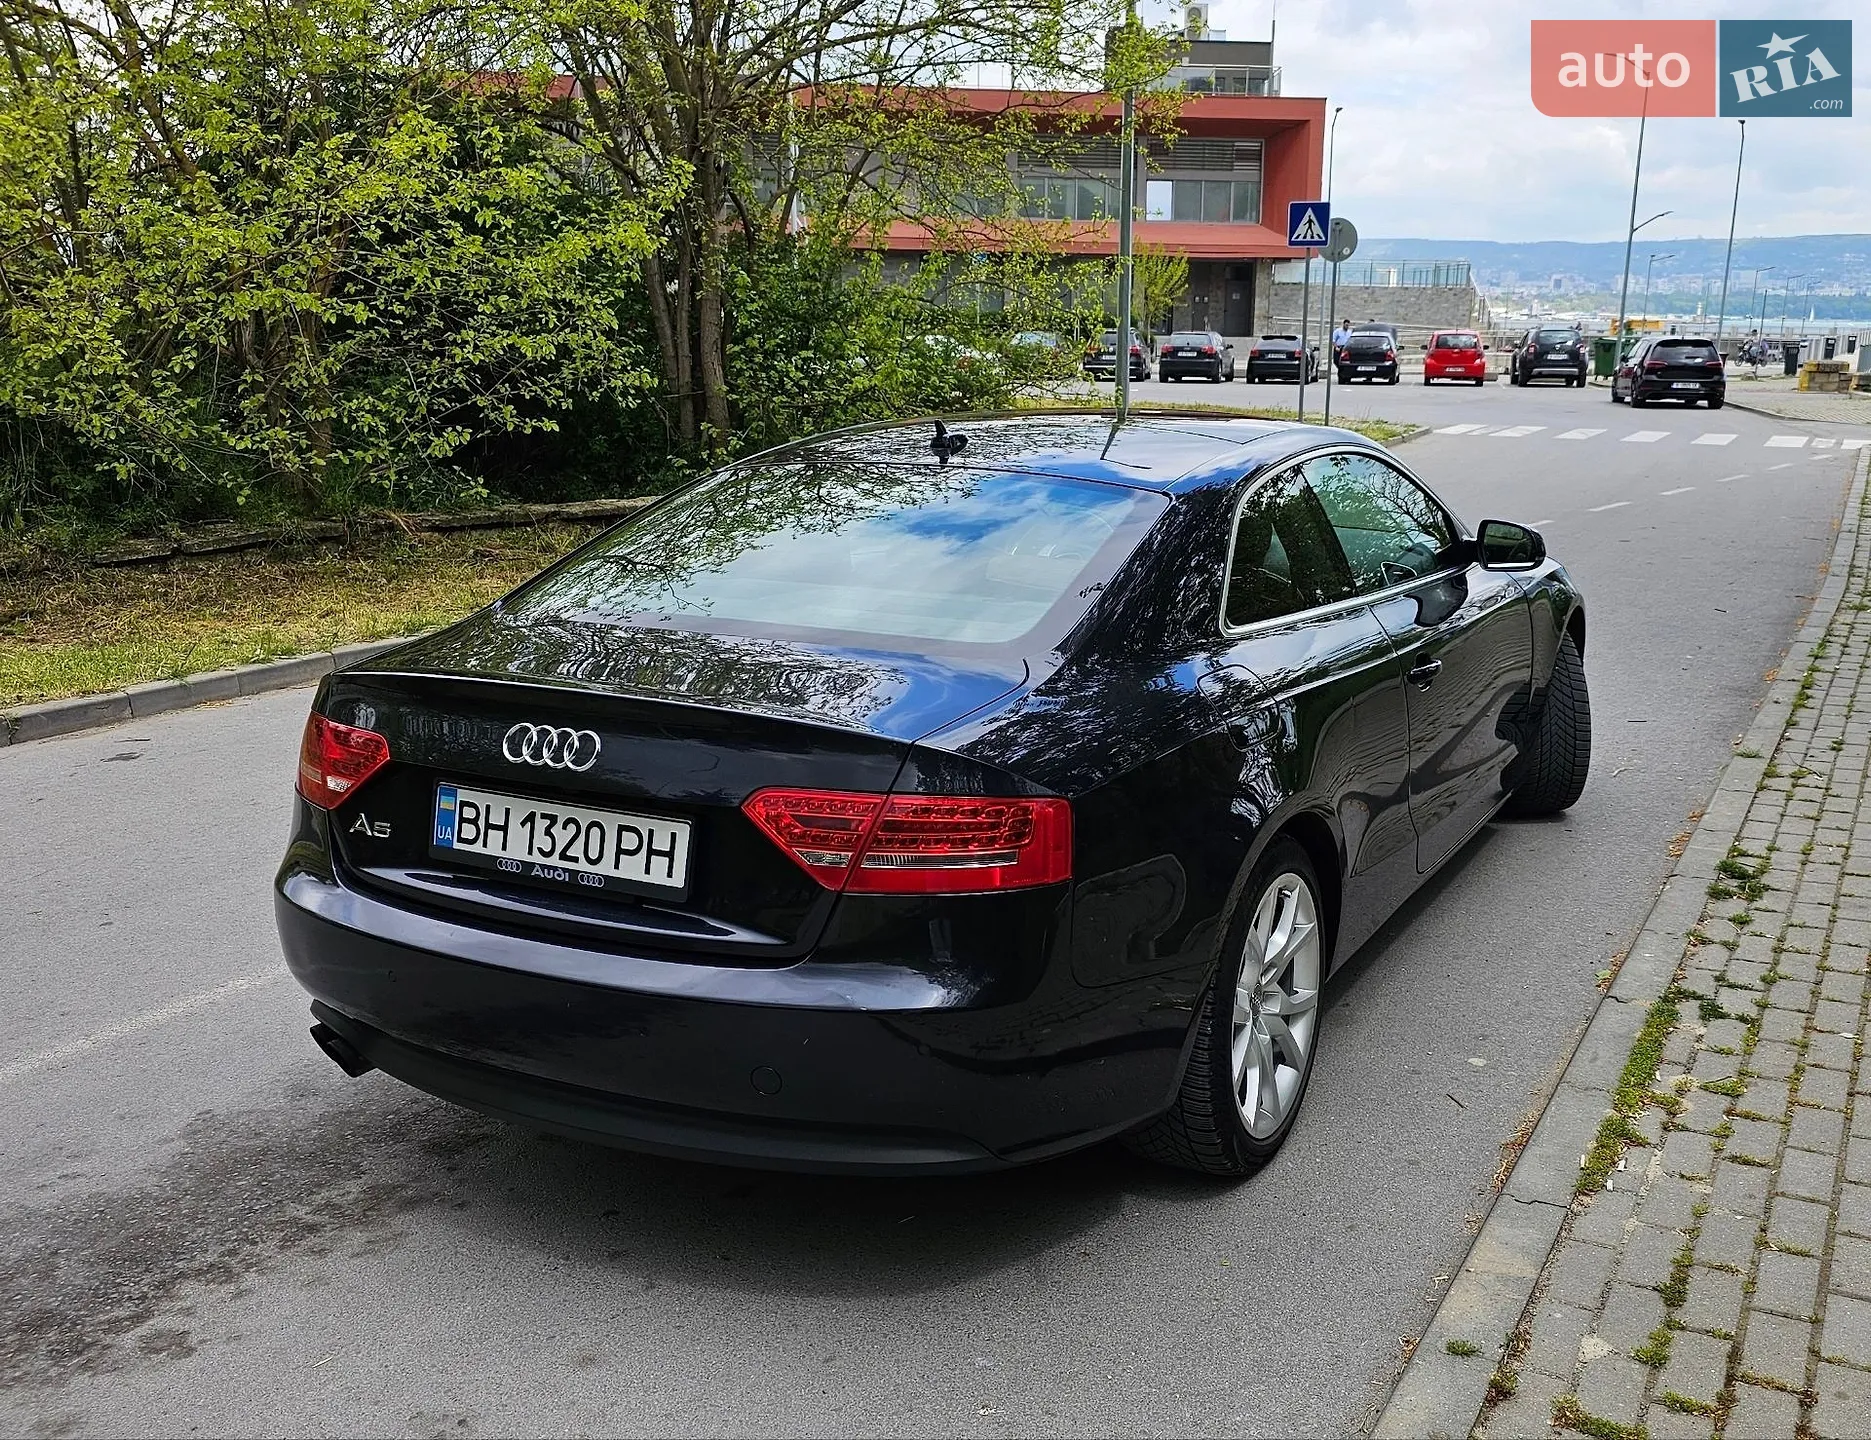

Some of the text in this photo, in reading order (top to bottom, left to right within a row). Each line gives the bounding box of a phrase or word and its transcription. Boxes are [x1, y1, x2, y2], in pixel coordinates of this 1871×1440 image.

[349, 812, 391, 838] A5
[437, 826, 452, 841] UA
[456, 800, 677, 878] BH 1320 PH
[531, 864, 569, 882] Audi
